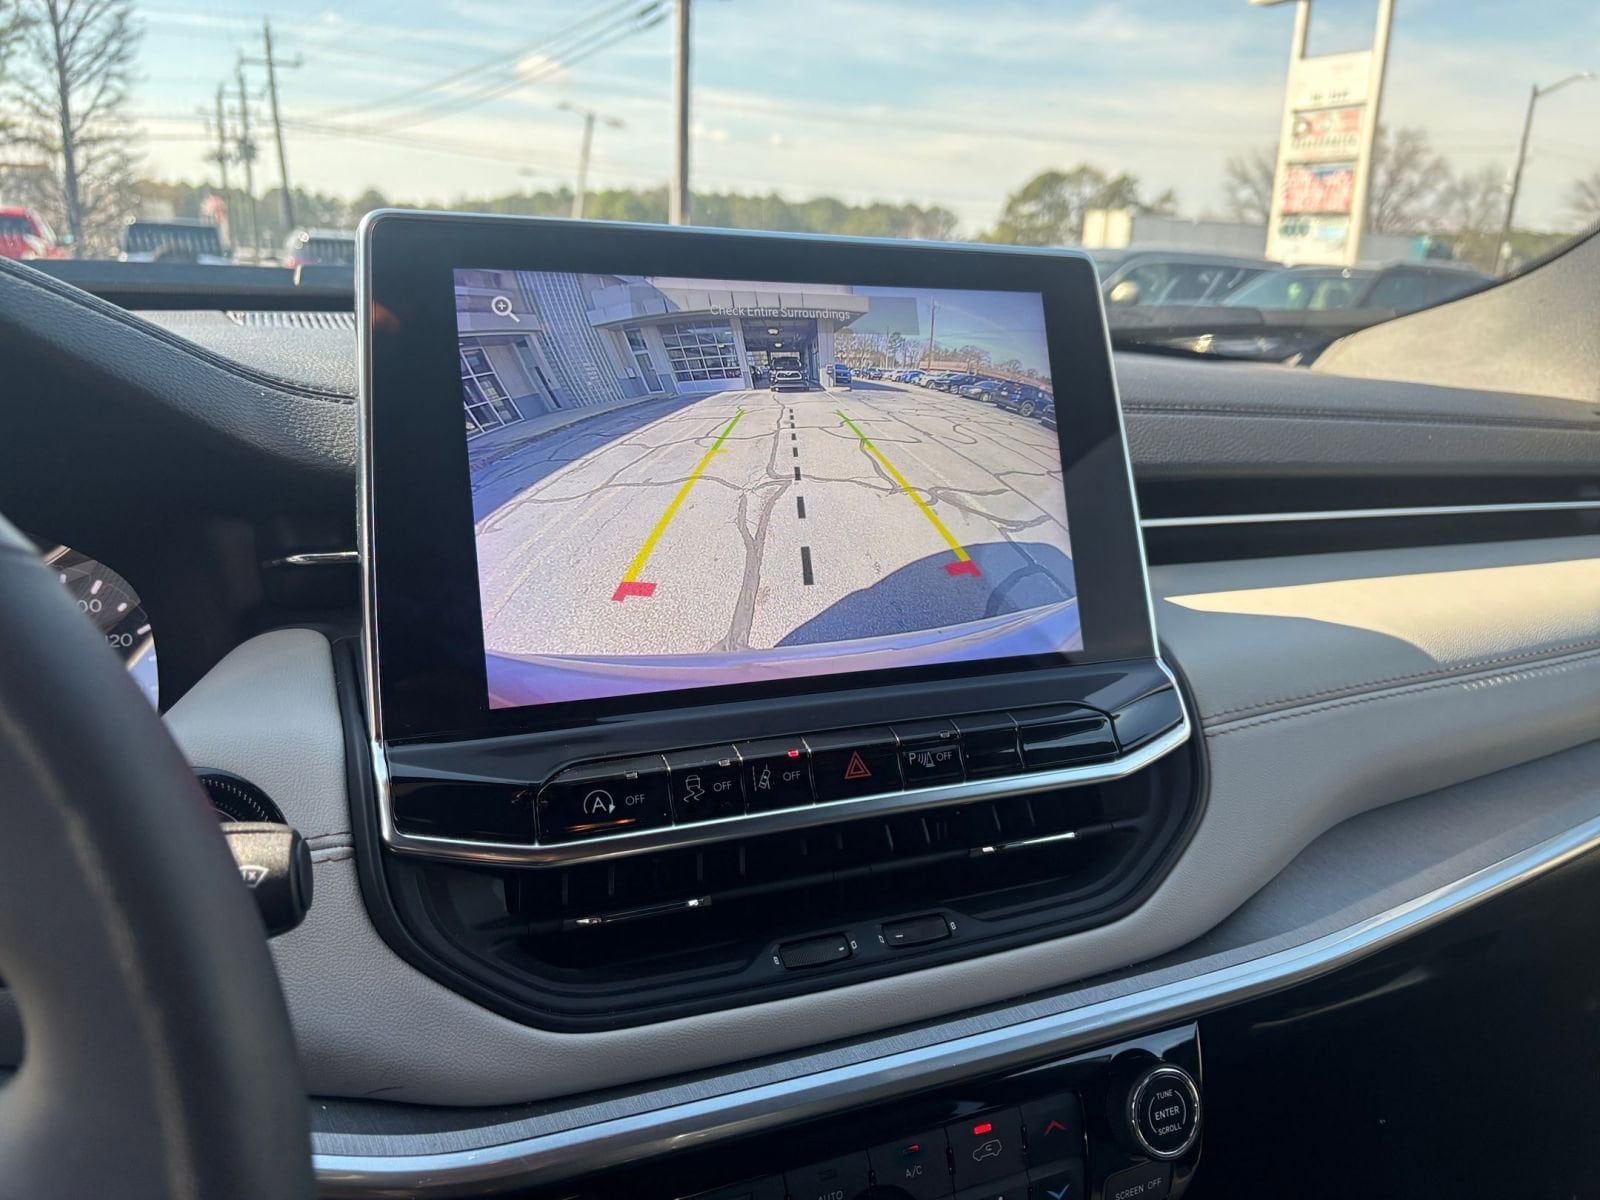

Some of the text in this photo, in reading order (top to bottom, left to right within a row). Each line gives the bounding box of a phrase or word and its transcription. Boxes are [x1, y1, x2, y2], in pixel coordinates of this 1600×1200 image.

[710, 304, 850, 321] Check Entire Surroundings
[77, 599, 102, 613] 00
[936, 751, 953, 762] OFF
[783, 770, 801, 782] OFF
[713, 780, 732, 792] OFF
[625, 793, 646, 806] OFF
[1156, 1089, 1174, 1100] TUNE
[1154, 1105, 1181, 1121] ENTER
[1158, 1122, 1182, 1136] SCROLL
[905, 1165, 923, 1178] A/C
[1115, 1177, 1163, 1200] SCREEN OFF
